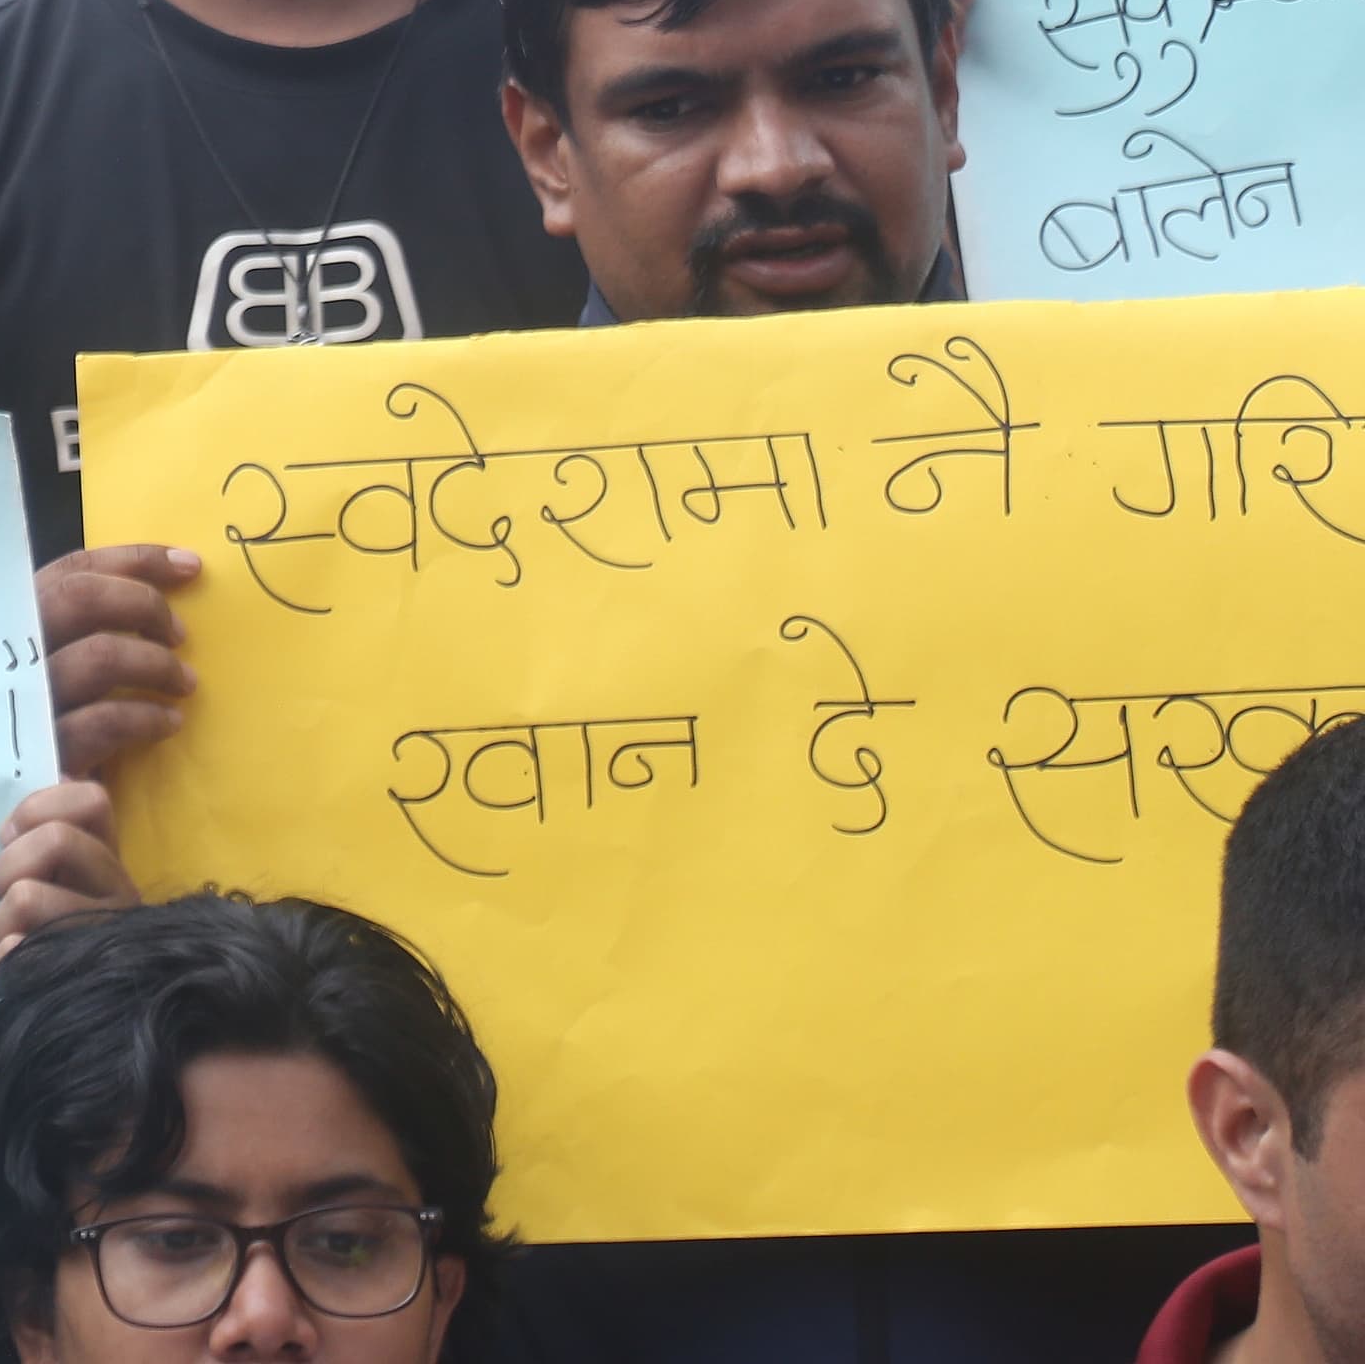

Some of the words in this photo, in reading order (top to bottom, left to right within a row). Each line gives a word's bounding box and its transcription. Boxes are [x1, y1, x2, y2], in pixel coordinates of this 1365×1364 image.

[1039, 129, 1295, 271] बालेन
[870, 335, 1041, 517] नै
[387, 714, 699, 878] खान
[778, 614, 917, 835] दे
[985, 683, 1365, 866] सरक
